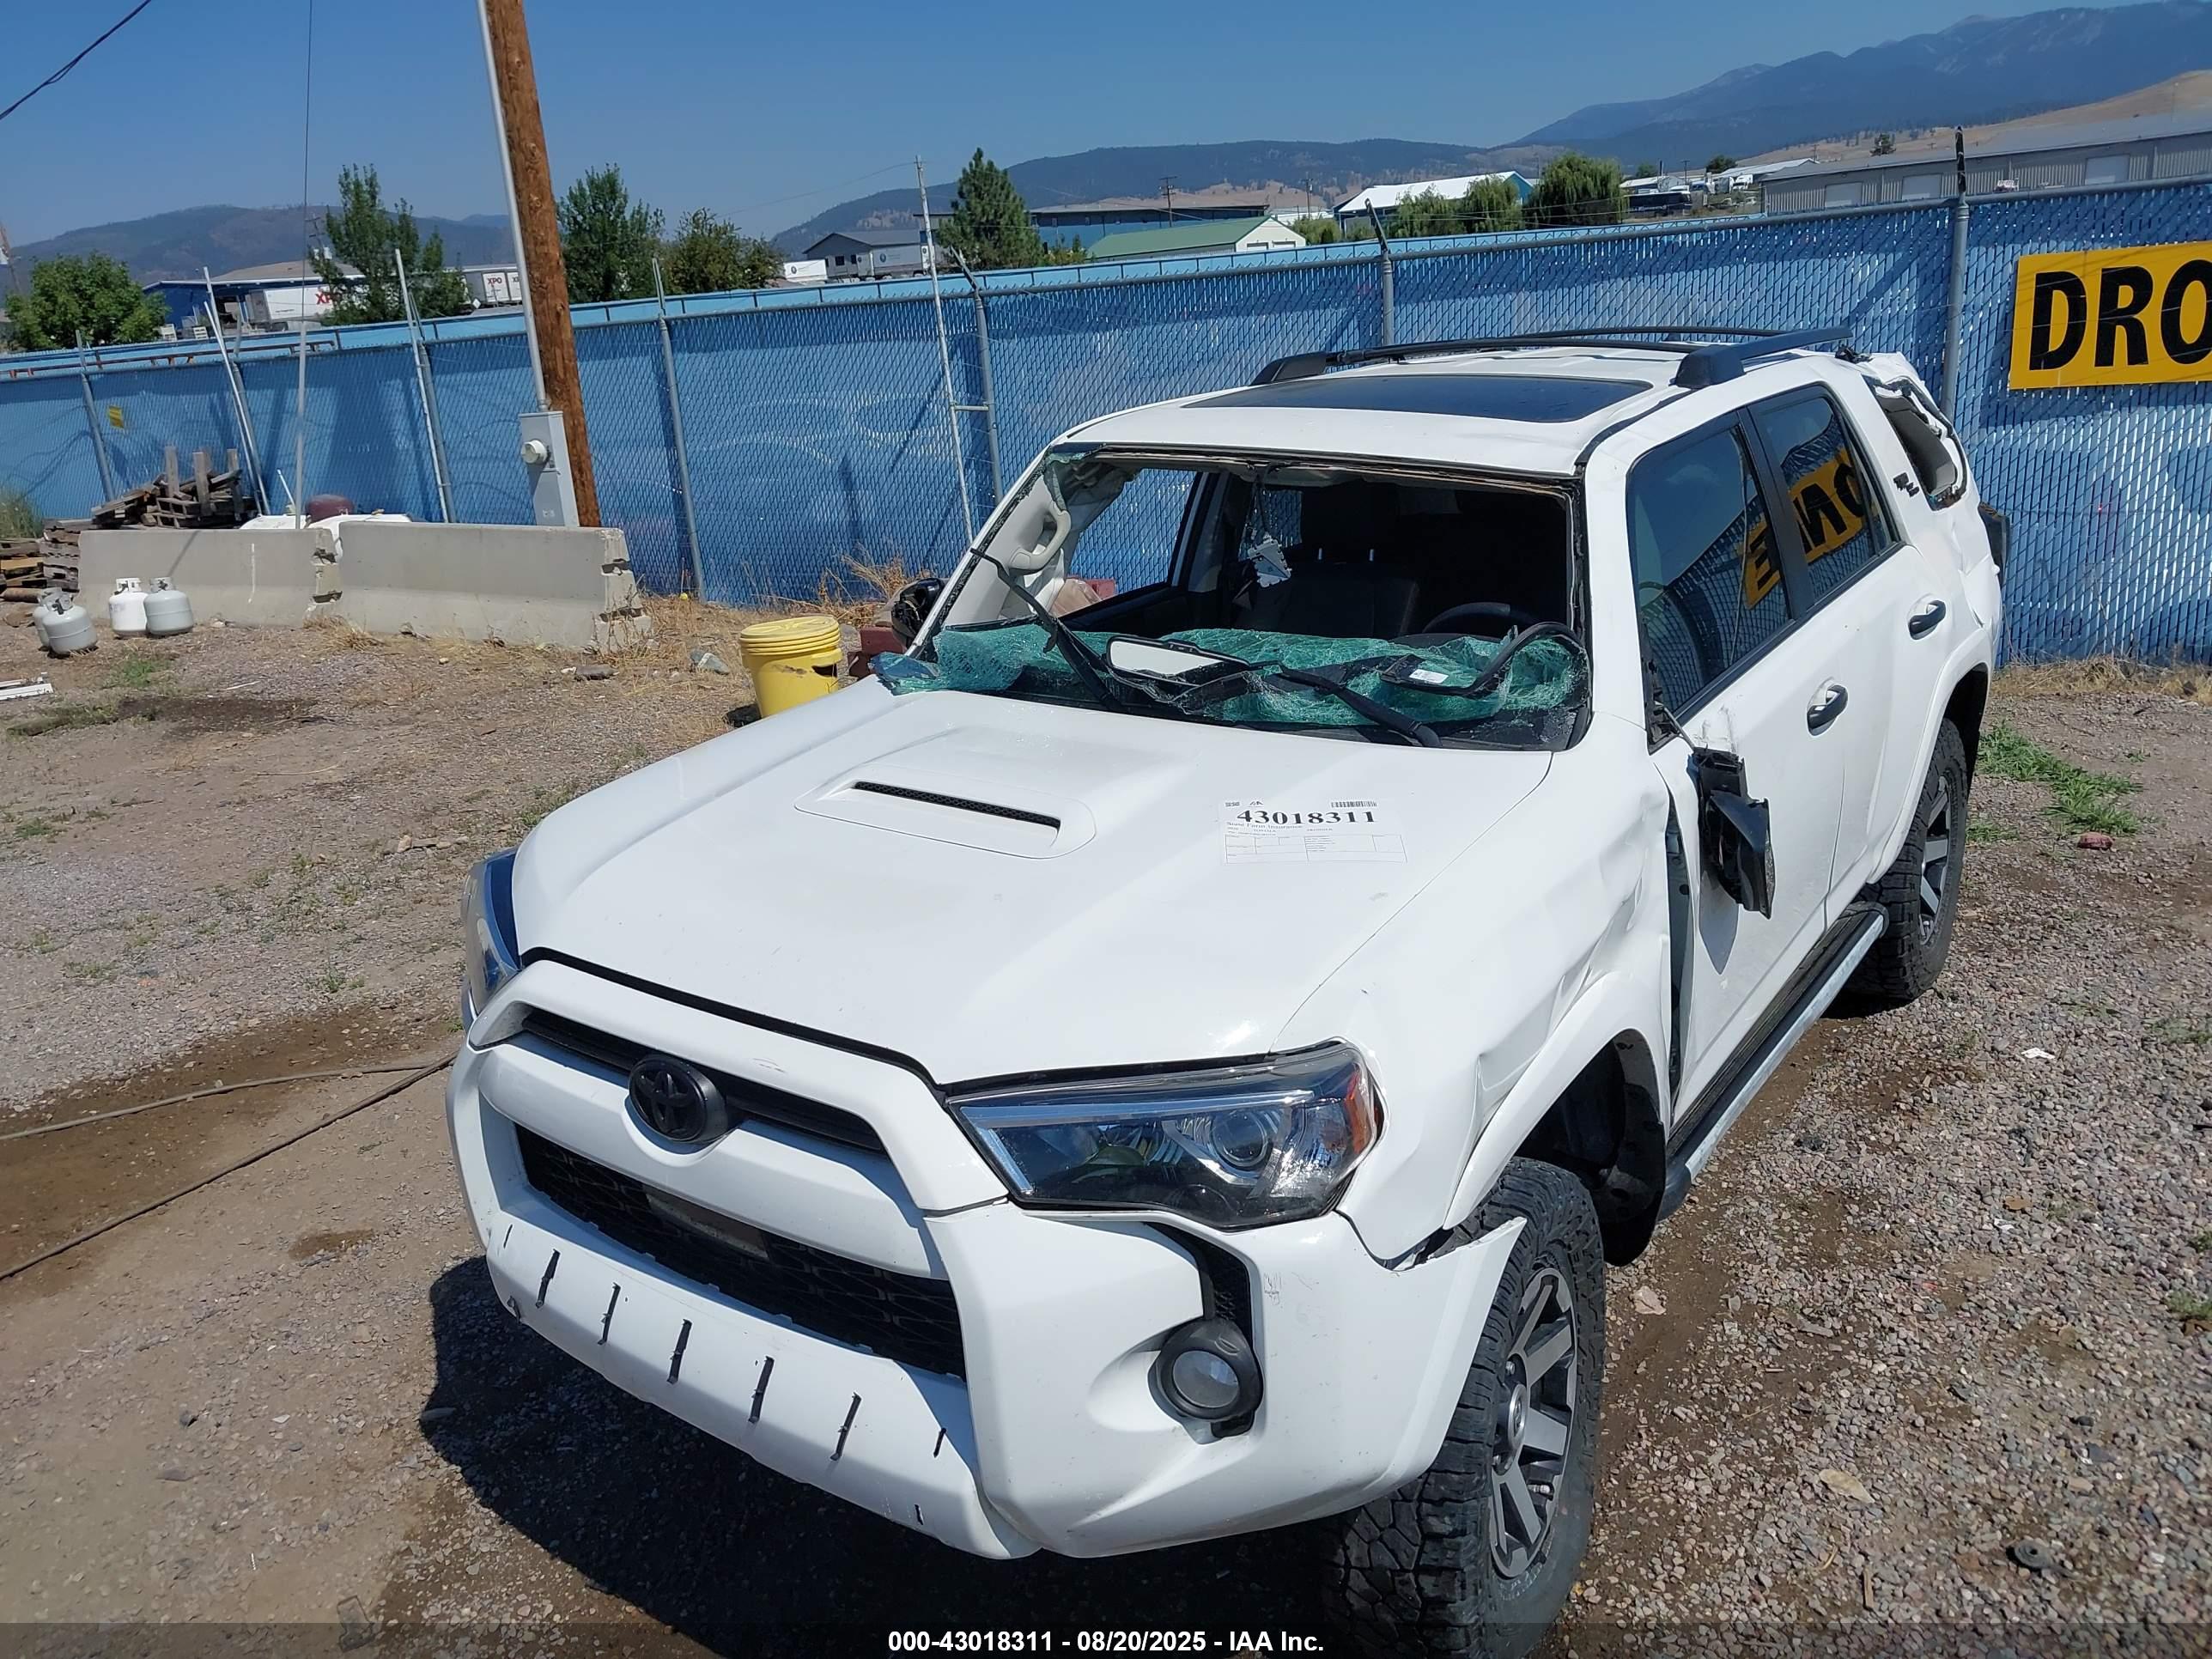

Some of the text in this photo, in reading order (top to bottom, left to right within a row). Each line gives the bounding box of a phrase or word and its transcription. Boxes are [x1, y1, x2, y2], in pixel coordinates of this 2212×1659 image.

[487, 276, 502, 285] XPO
[2029, 259, 2212, 371] DRO
[1237, 810, 1376, 824] 43018311
